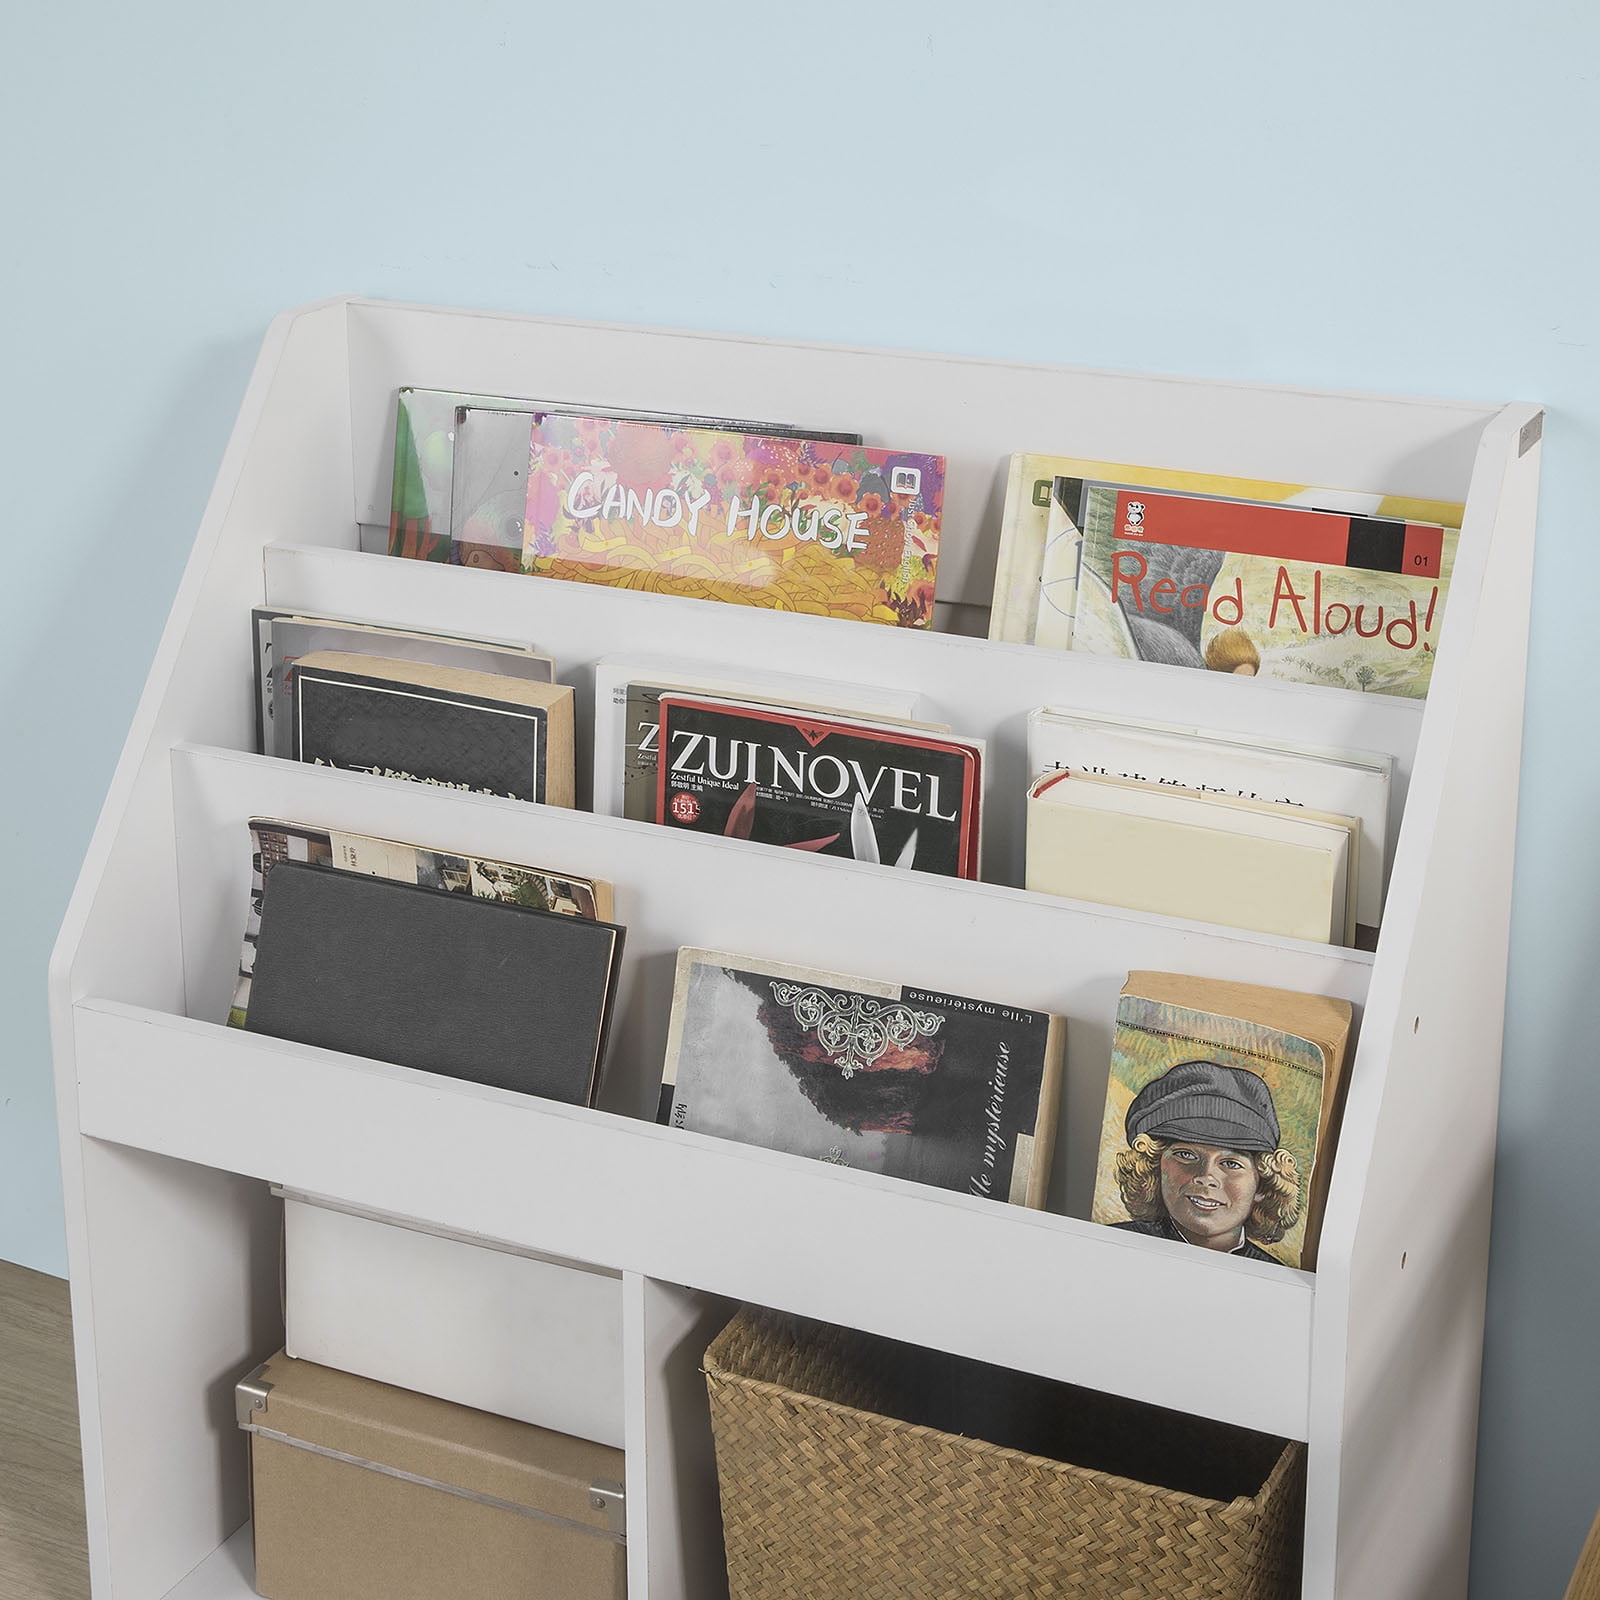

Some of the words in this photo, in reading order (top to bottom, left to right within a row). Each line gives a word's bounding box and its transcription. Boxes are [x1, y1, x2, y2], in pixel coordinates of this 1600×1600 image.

[567, 471, 711, 536] CANDY
[726, 494, 870, 552] HOUSE
[1414, 555, 1429, 567] 01
[1110, 550, 1244, 626] Read
[1268, 566, 1438, 652] Aloud!
[671, 772, 696, 783] Zestful
[697, 777, 721, 788] Unique
[722, 780, 739, 790] Ideal
